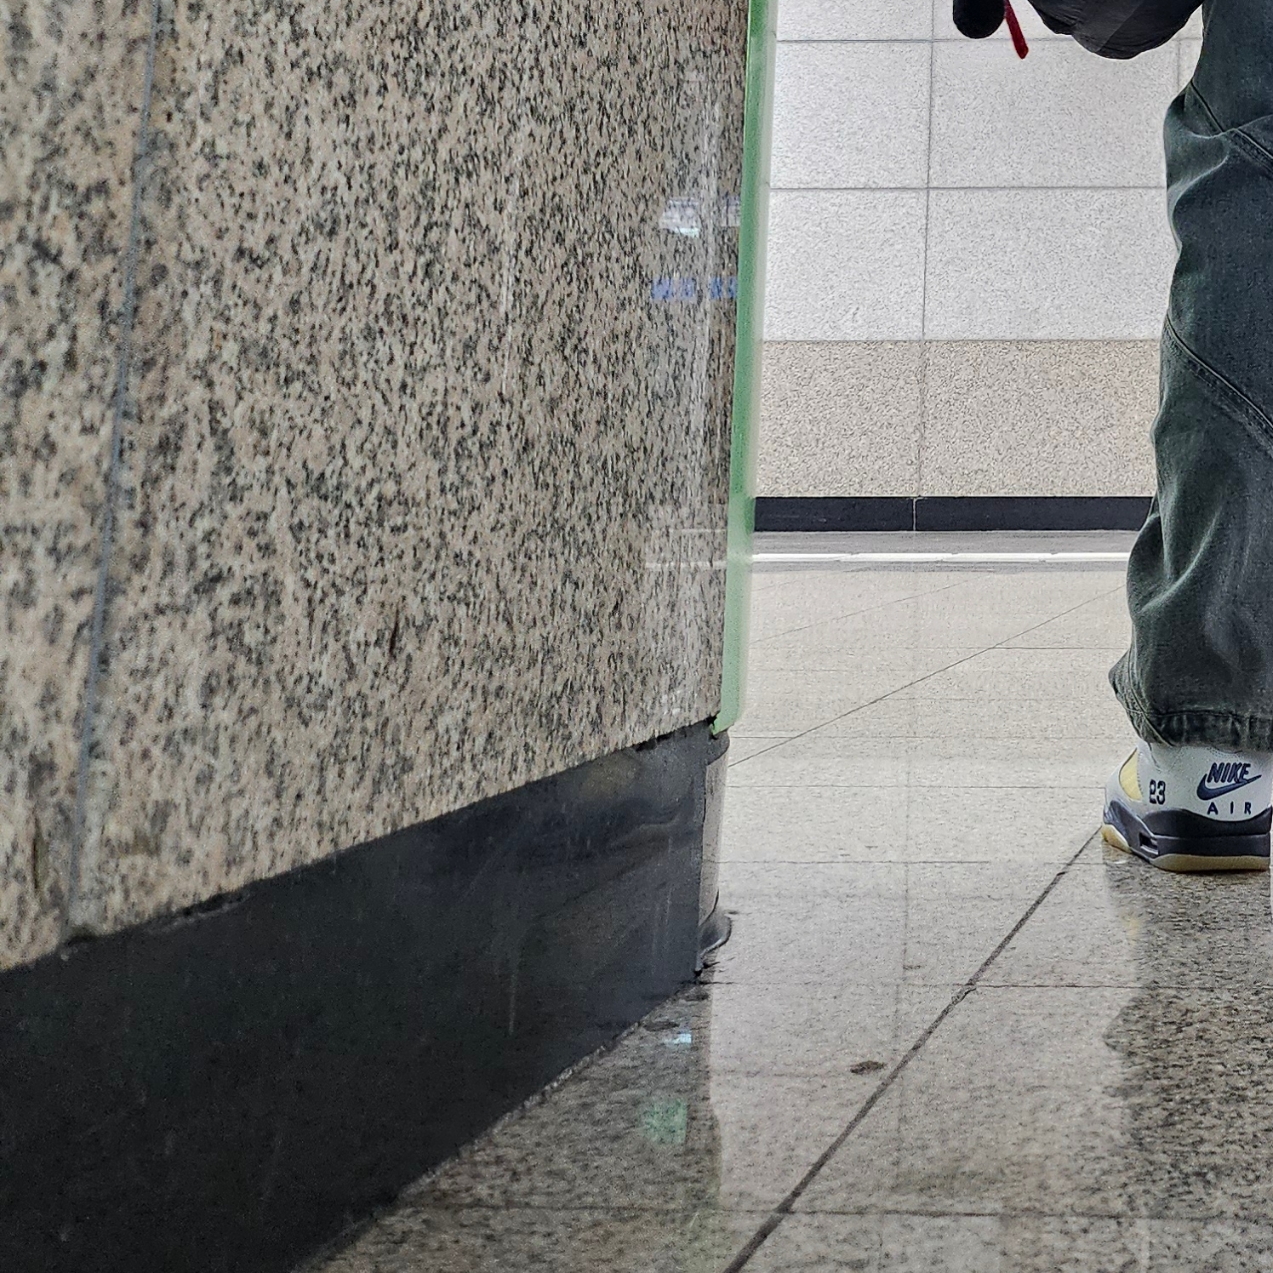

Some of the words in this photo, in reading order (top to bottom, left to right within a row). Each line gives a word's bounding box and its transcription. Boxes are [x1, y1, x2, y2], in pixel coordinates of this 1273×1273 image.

[1206, 761, 1252, 784] NIKE
[1148, 778, 1167, 805] 23
[1206, 800, 1252, 815] AIR
